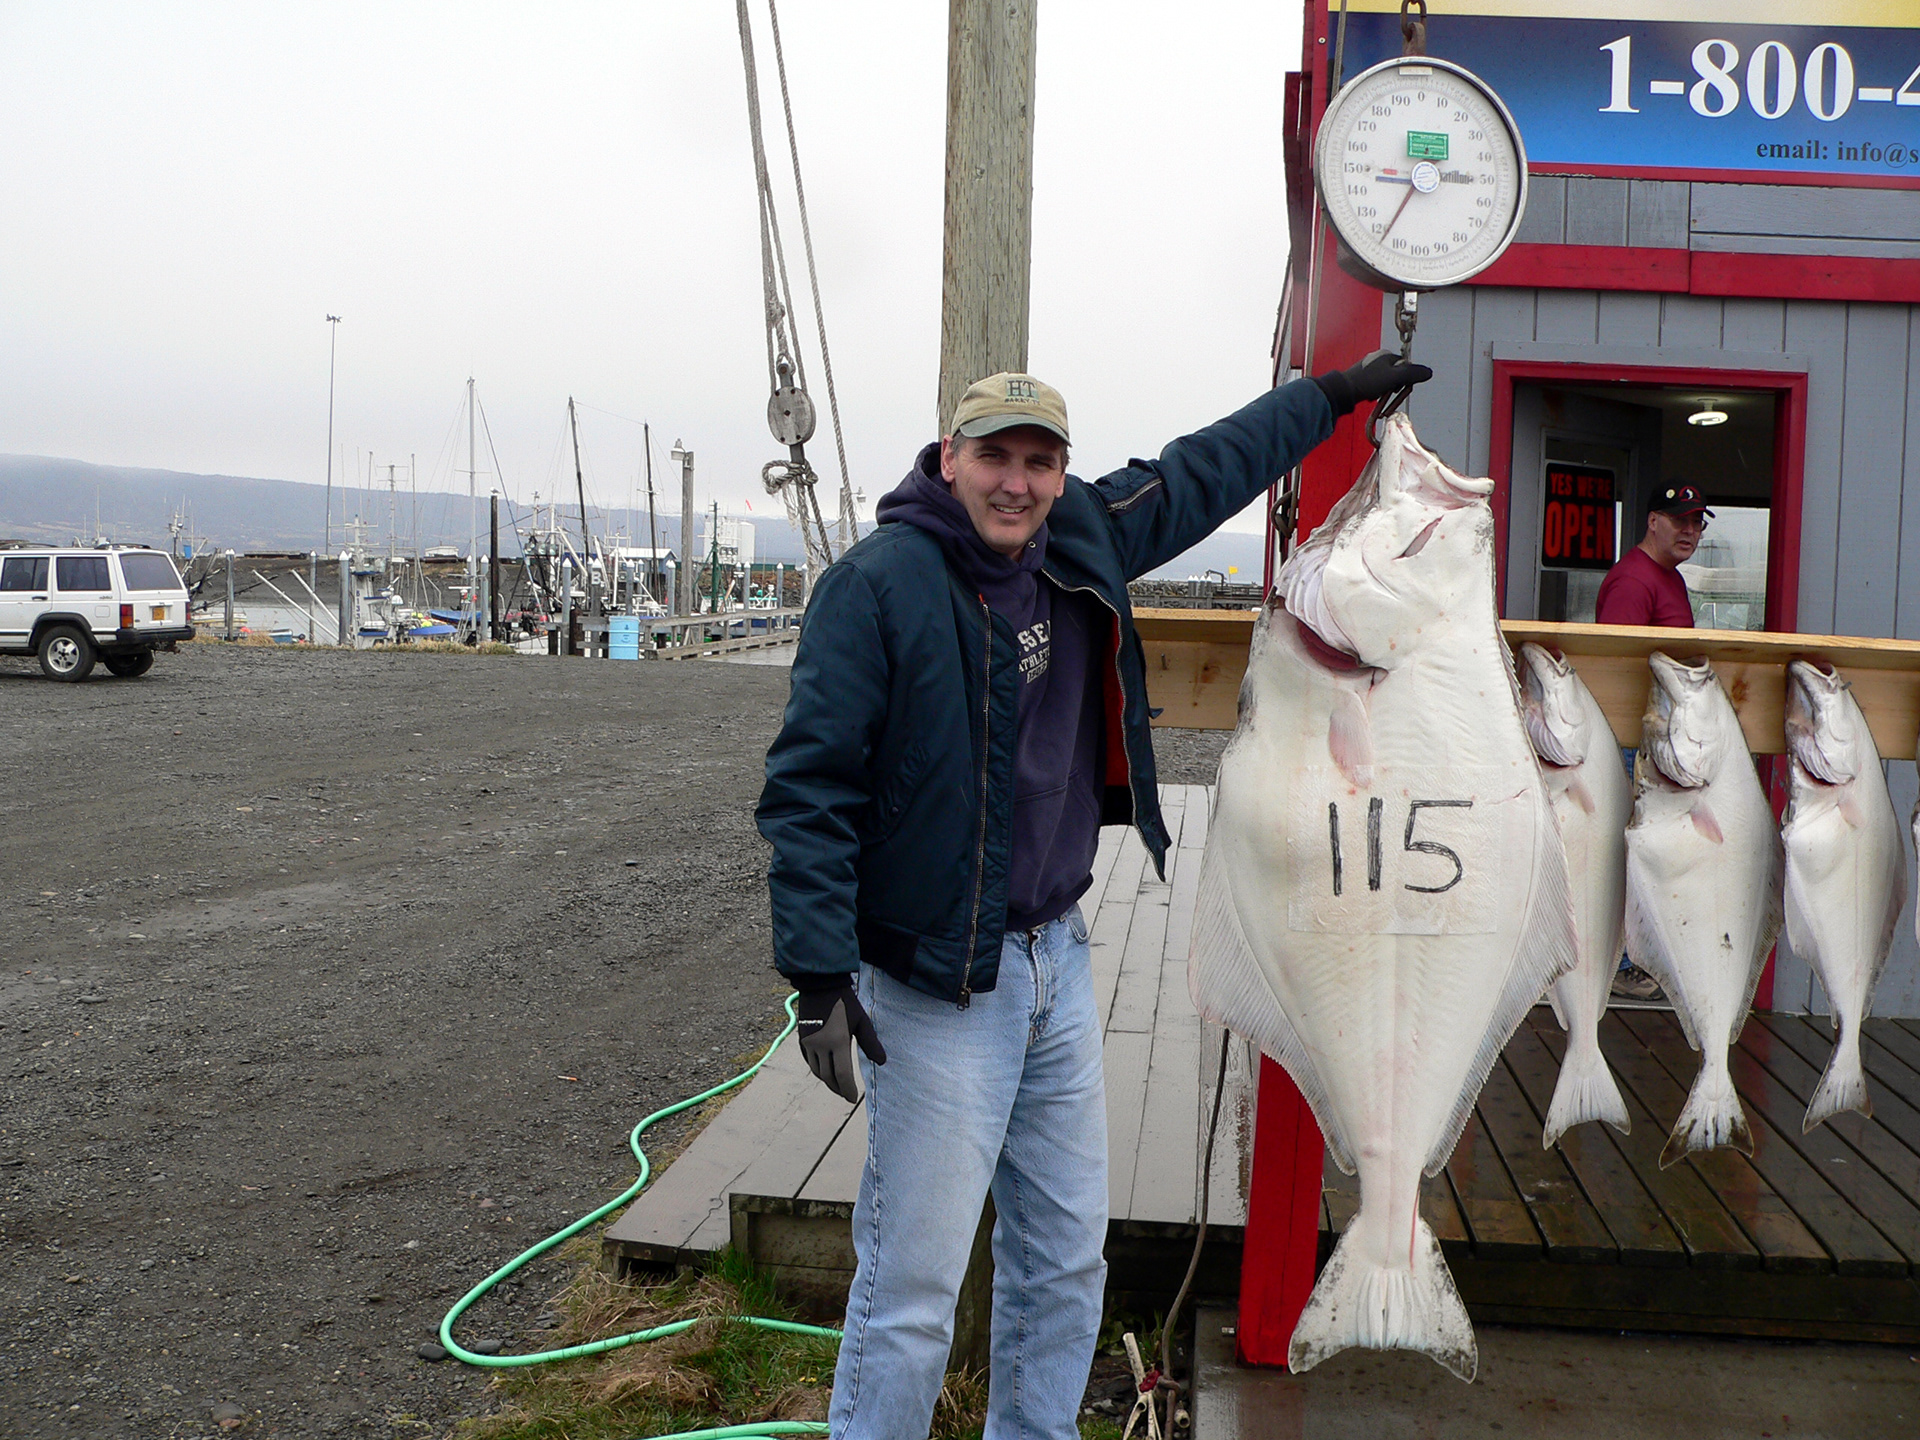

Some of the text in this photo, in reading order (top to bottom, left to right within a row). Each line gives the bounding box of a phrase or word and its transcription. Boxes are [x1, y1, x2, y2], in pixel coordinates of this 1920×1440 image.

[1598, 35, 1920, 122] 1-800-4
[1391, 95, 1411, 106] 190
[1417, 91, 1425, 102] 0
[1436, 97, 1448, 108] 10
[1371, 105, 1391, 117] 180
[1453, 111, 1469, 122] 20
[1357, 121, 1376, 132] 170
[1468, 130, 1483, 141] 30
[1348, 141, 1367, 152] 160
[1477, 151, 1492, 162] 40
[1756, 140, 1919, 168] email: info@s
[1344, 162, 1363, 173] 150
[1479, 174, 1495, 185] 50
[1347, 184, 1367, 195] 140
[1476, 197, 1491, 208] 60
[1356, 206, 1376, 217] 130
[1468, 217, 1482, 228] 70
[1452, 232, 1468, 243] 80
[1392, 238, 1407, 249] 110
[1433, 242, 1449, 253] 90
[1410, 245, 1430, 256] 100
[1007, 380, 1036, 398] HT
[1550, 472, 1612, 500] YES WE'RE
[1544, 501, 1613, 560] OPEN
[1329, 797, 1473, 897] 115
